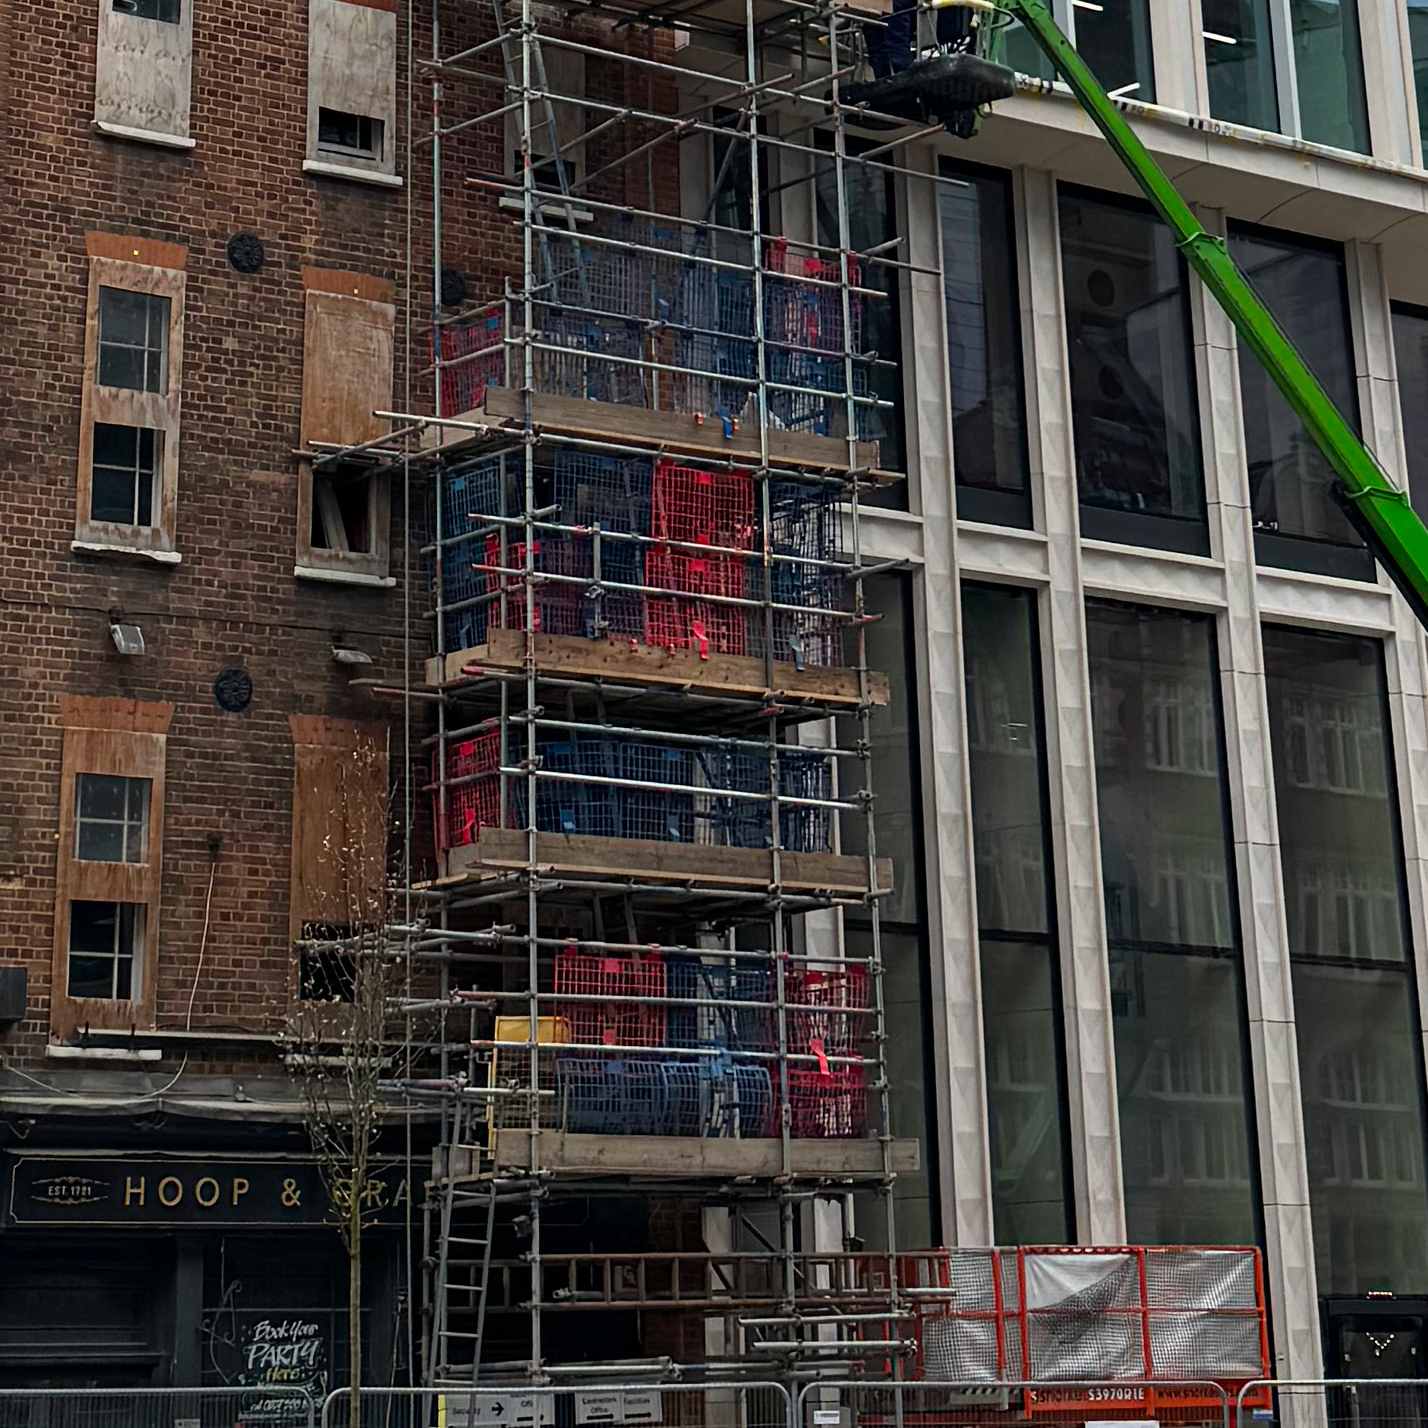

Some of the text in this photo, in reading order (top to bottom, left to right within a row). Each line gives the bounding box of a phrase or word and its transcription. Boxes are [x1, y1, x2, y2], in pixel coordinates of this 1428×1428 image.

[124, 1176, 414, 1208] HOOP & GRA
[247, 1340, 320, 1370] PARTY
